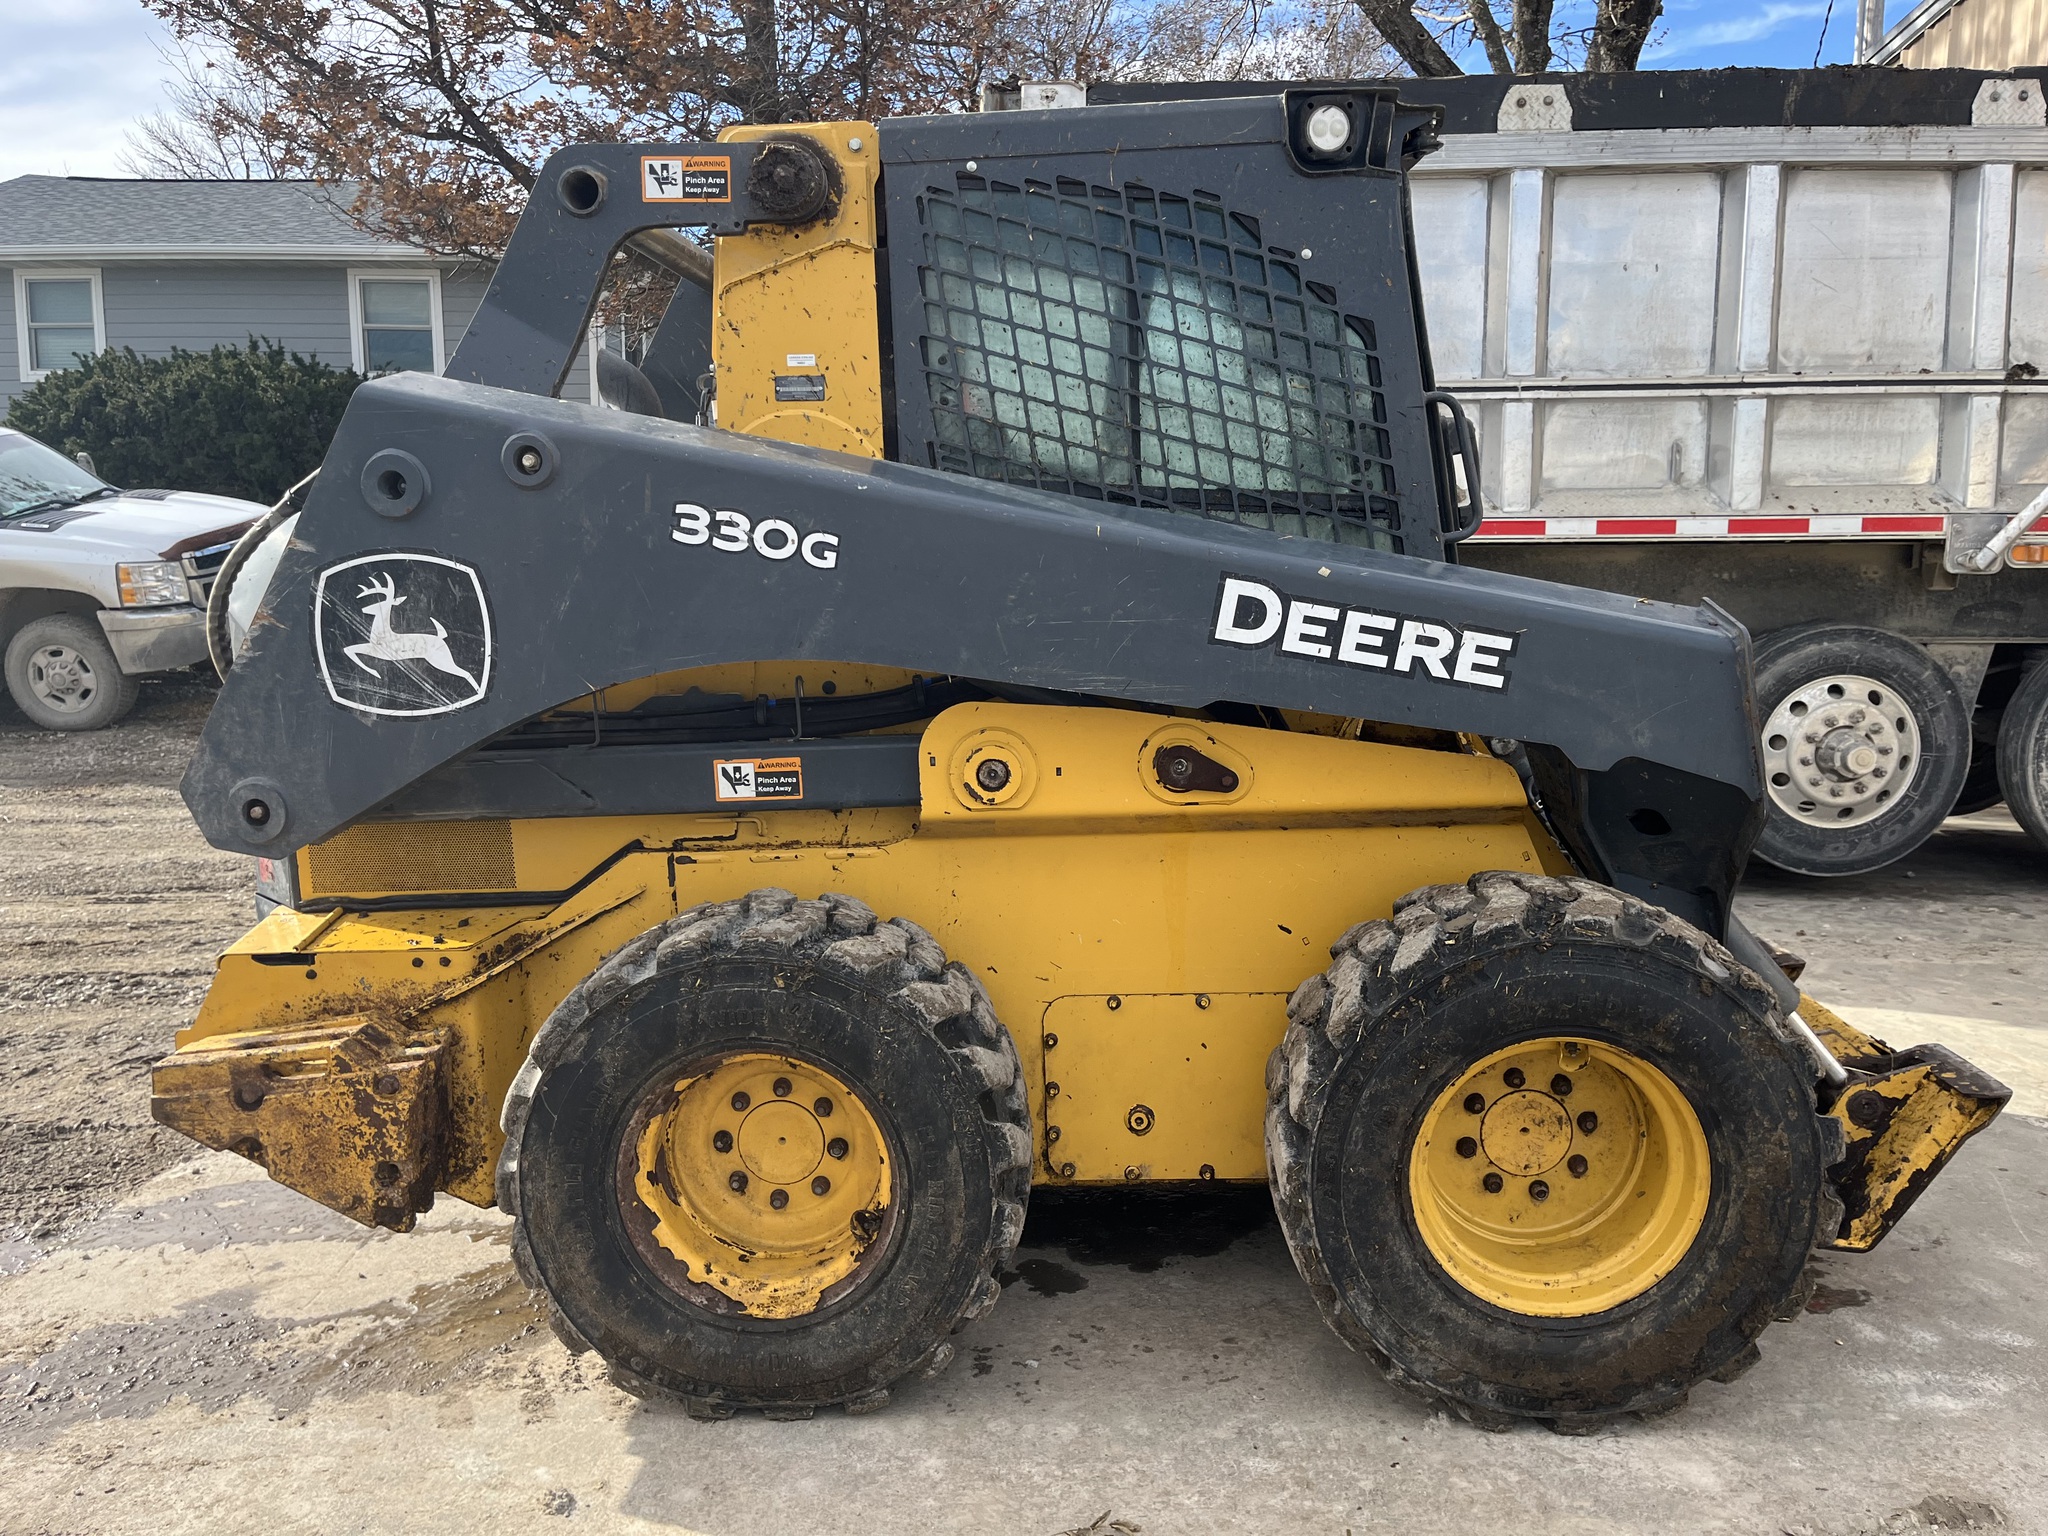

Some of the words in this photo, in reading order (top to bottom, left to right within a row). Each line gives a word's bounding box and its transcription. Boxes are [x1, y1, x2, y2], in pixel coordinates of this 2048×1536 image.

[692, 160, 726, 168] WARNING
[685, 176, 706, 184] Pinch
[685, 186, 702, 194] Keep
[702, 186, 720, 194] Away
[672, 503, 839, 569] 330G
[1214, 578, 1514, 689] DEERE
[764, 761, 797, 769] WARNING
[757, 776, 779, 784] Pinch
[779, 776, 797, 784] Area
[758, 785, 775, 793] Keep
[775, 785, 792, 793] Away
